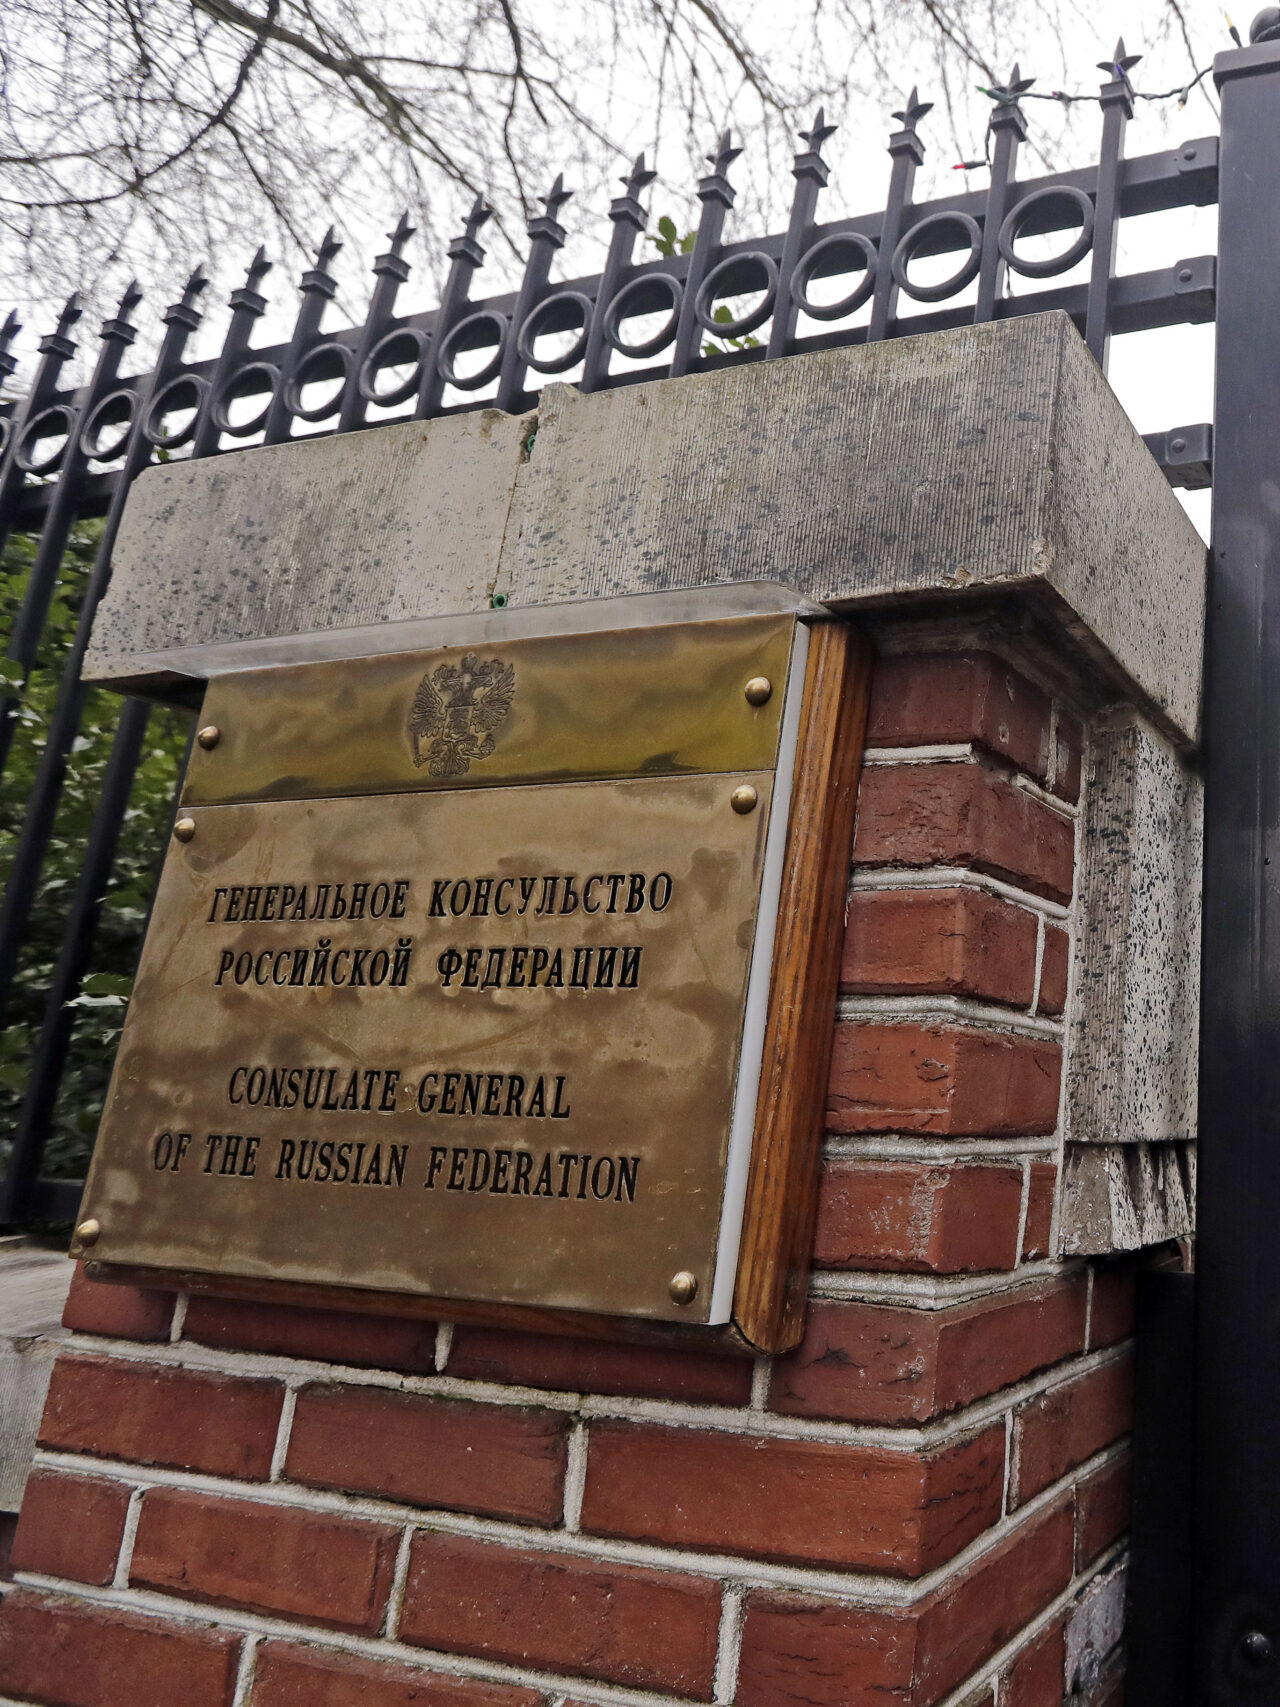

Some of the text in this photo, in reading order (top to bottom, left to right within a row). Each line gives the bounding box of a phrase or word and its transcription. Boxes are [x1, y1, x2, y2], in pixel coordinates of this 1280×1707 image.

[206, 872, 672, 924] ГЕНЕРАЛЬНОЕ КОНСУЛЬСТВО
[215, 938, 643, 990] РОССИЙСКОЙ ФЕДЕРАЦИИ
[228, 1067, 571, 1119] CONSULATE GENERAL
[154, 1133, 640, 1201] OF THE RUSSIAN FEDERATION
